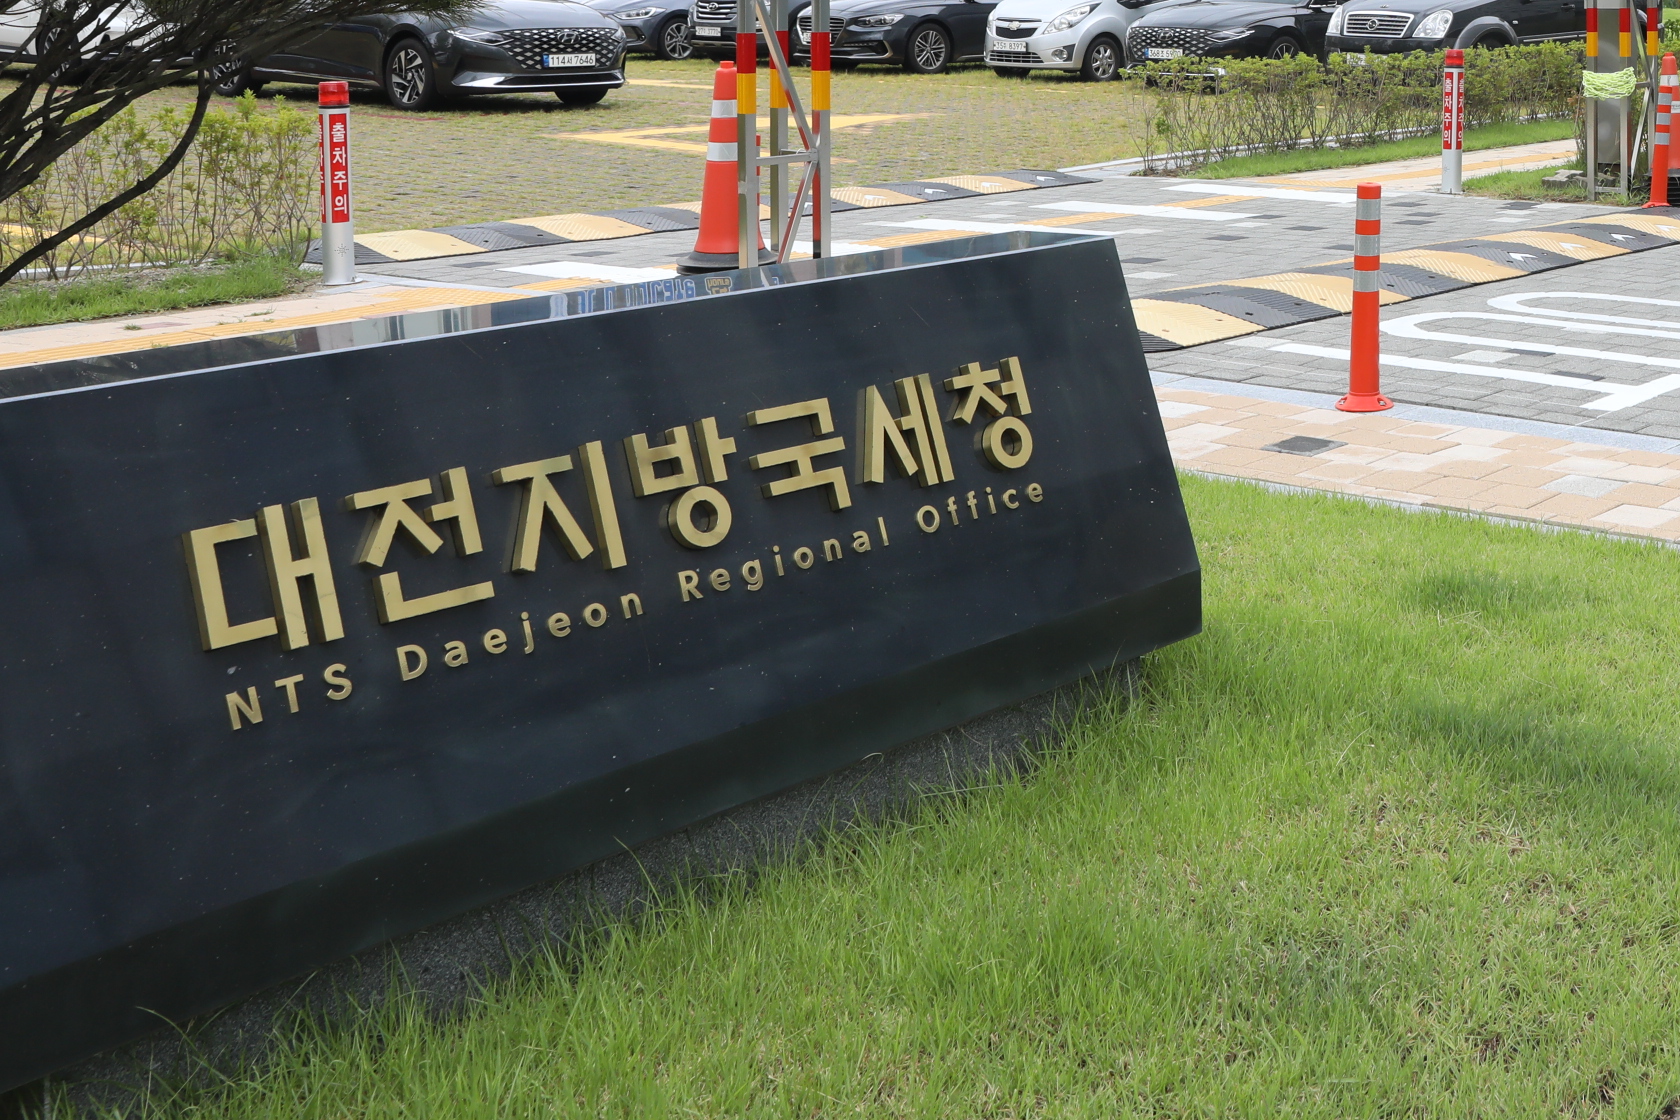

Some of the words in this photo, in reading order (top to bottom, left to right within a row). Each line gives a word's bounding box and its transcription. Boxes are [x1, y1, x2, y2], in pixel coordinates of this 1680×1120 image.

[331, 122, 348, 215] 출차주의
[1443, 77, 1452, 144] 출차주의
[181, 354, 1035, 654] 대전지방국세청
[223, 660, 356, 733] NTS
[395, 587, 646, 684] Daejeon
[676, 514, 891, 606] Regional
[914, 478, 1047, 536] Office
